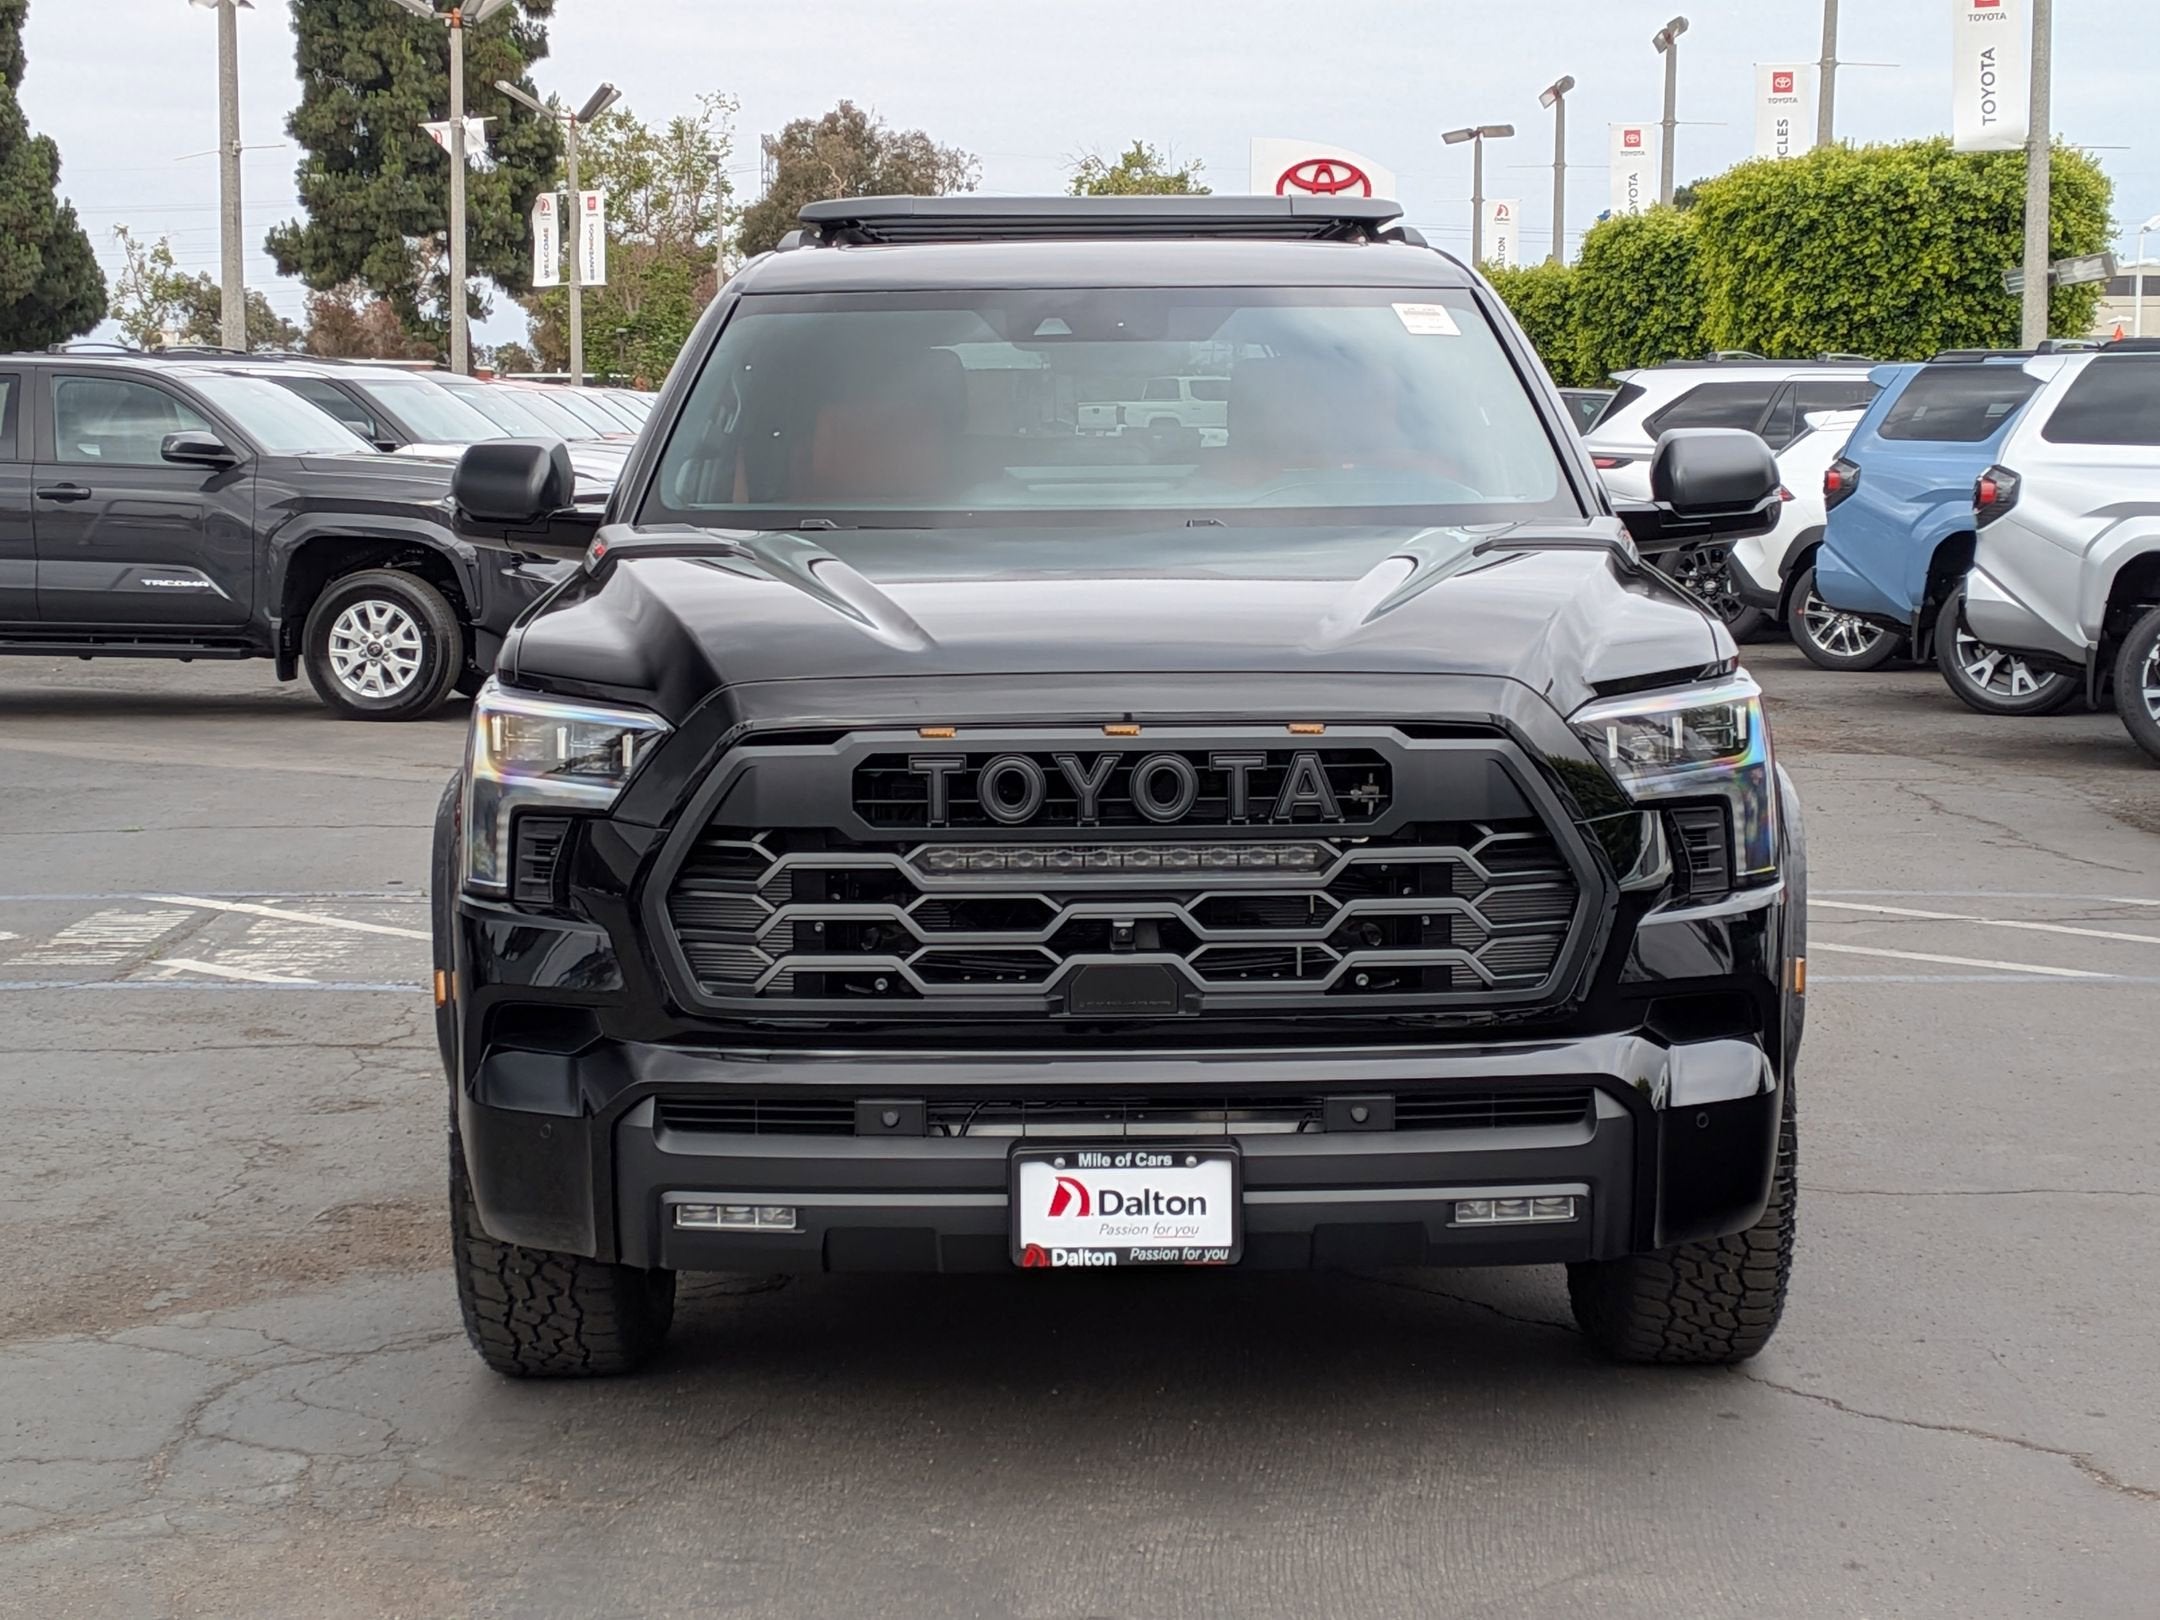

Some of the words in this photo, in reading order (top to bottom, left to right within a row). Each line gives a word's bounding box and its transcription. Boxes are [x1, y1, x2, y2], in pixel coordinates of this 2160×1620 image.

[1968, 12, 2007, 22] TOYOTA
[1980, 47, 1997, 126] TOYOTA
[1767, 97, 1799, 105] TOYOTA
[1628, 172, 1639, 216] OYOTA
[543, 227, 551, 279] WELCOME
[141, 579, 209, 588] TACOMA
[908, 750, 1346, 828] TOYOTA
[1078, 1153, 1110, 1168] Mile
[1114, 1152, 1132, 1168] of
[1135, 1152, 1173, 1167] Cars
[1099, 1188, 1207, 1217] Dalton
[1099, 1223, 1149, 1236] Passion
[1152, 1222, 1172, 1236] for
[1174, 1225, 1200, 1238] you
[1051, 1249, 1118, 1267] Dalton
[1130, 1248, 1179, 1261] Passion
[1182, 1248, 1201, 1261] for
[1202, 1249, 1230, 1263] you
